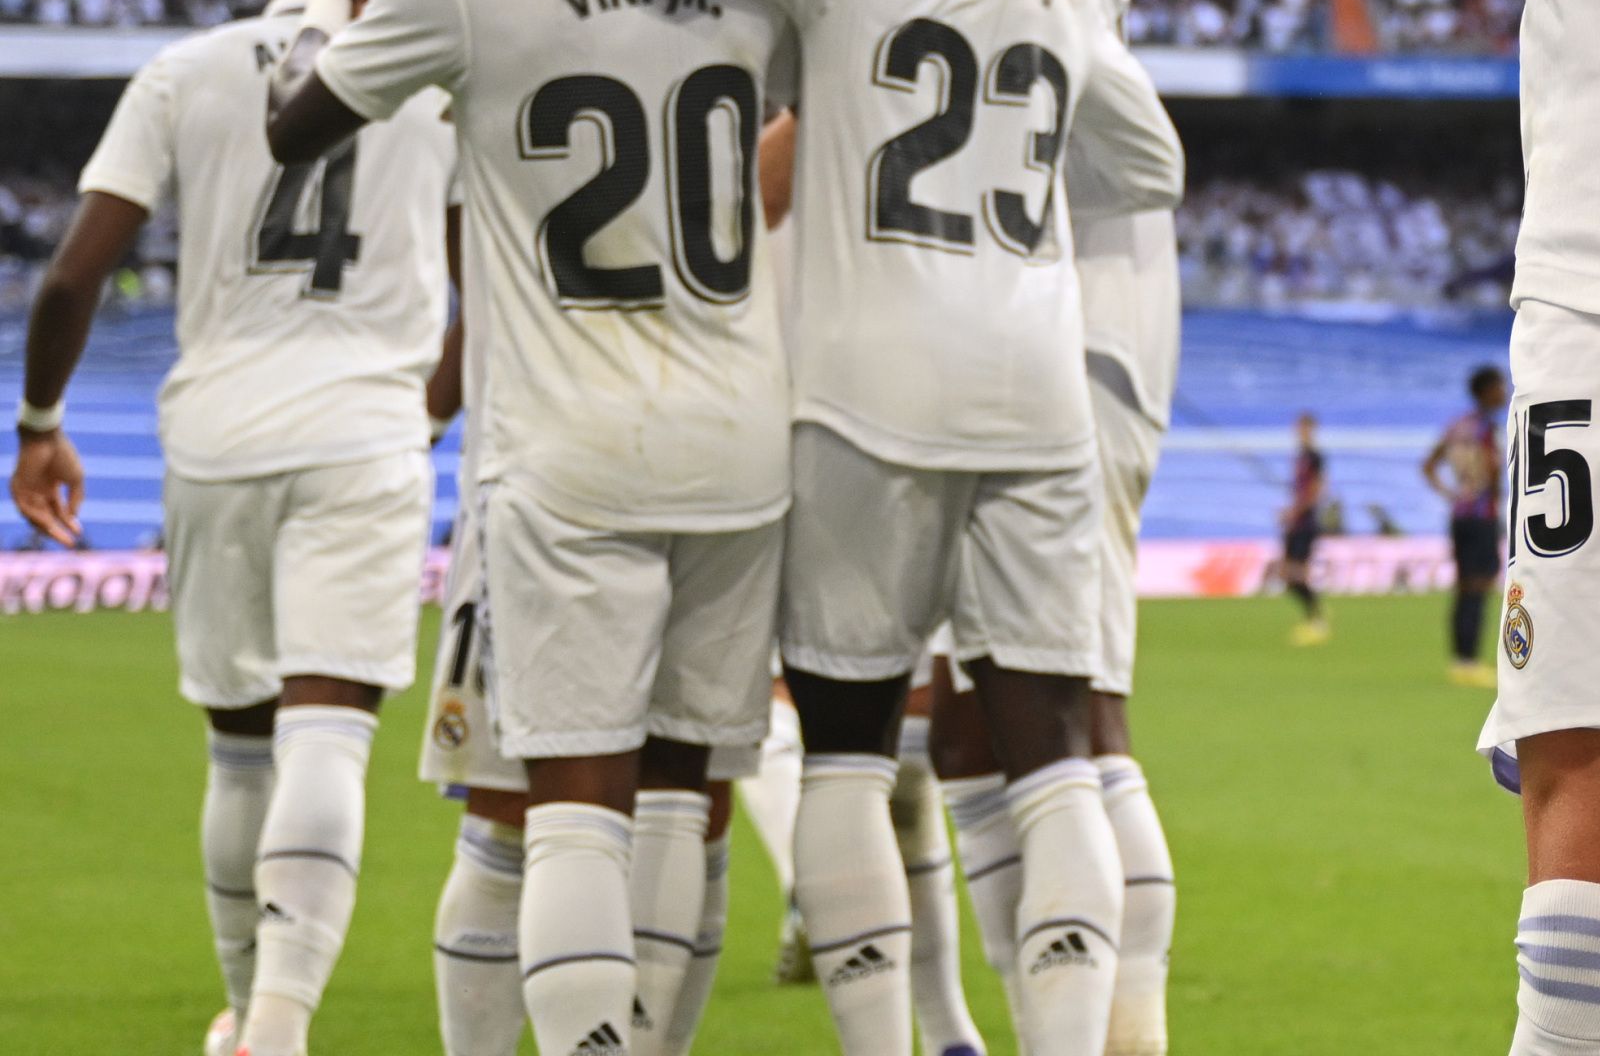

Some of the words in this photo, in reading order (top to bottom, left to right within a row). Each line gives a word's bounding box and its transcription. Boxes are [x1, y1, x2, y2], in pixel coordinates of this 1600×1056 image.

[245, 132, 362, 302] 4
[516, 64, 758, 311] 20
[866, 17, 1069, 267] 23
